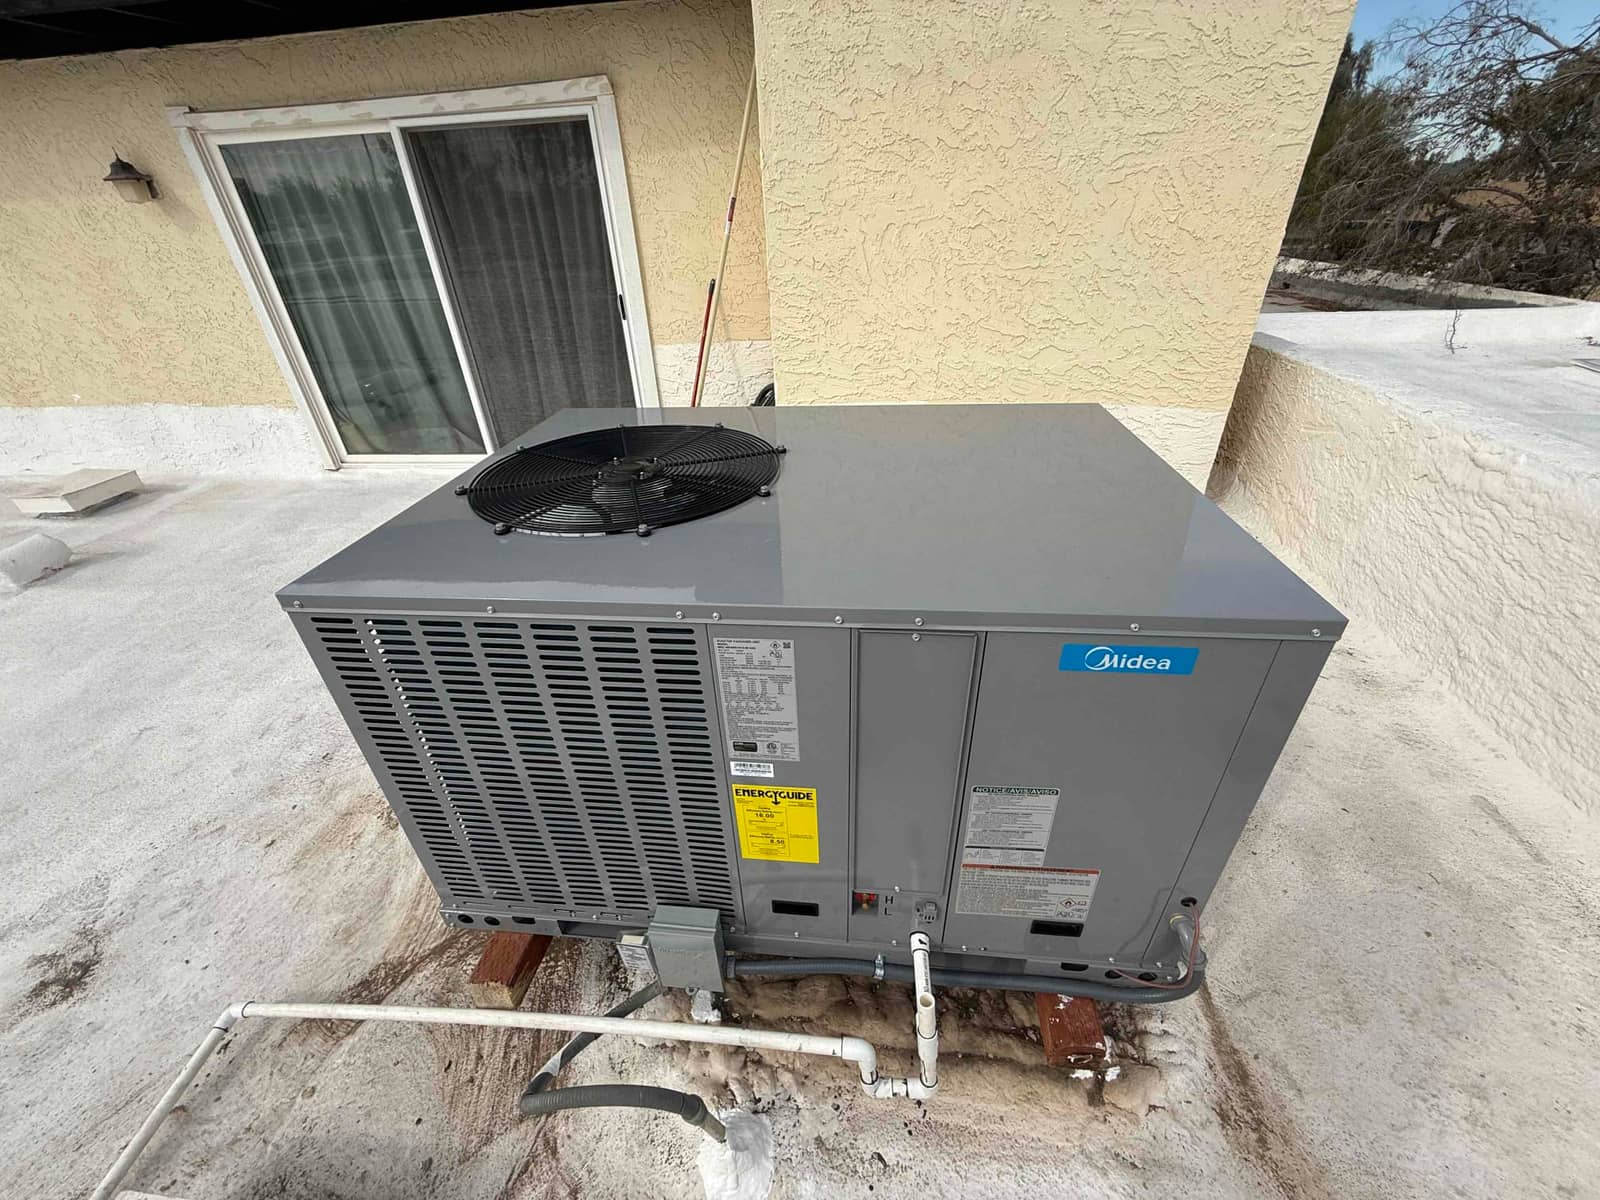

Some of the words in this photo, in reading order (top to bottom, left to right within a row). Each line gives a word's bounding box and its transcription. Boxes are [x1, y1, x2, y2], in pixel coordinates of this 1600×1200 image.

[1085, 647, 1171, 671] Midea
[735, 788, 814, 804] ENERGYGUIDE
[884, 895, 894, 905] H
[884, 906, 893, 916] L
